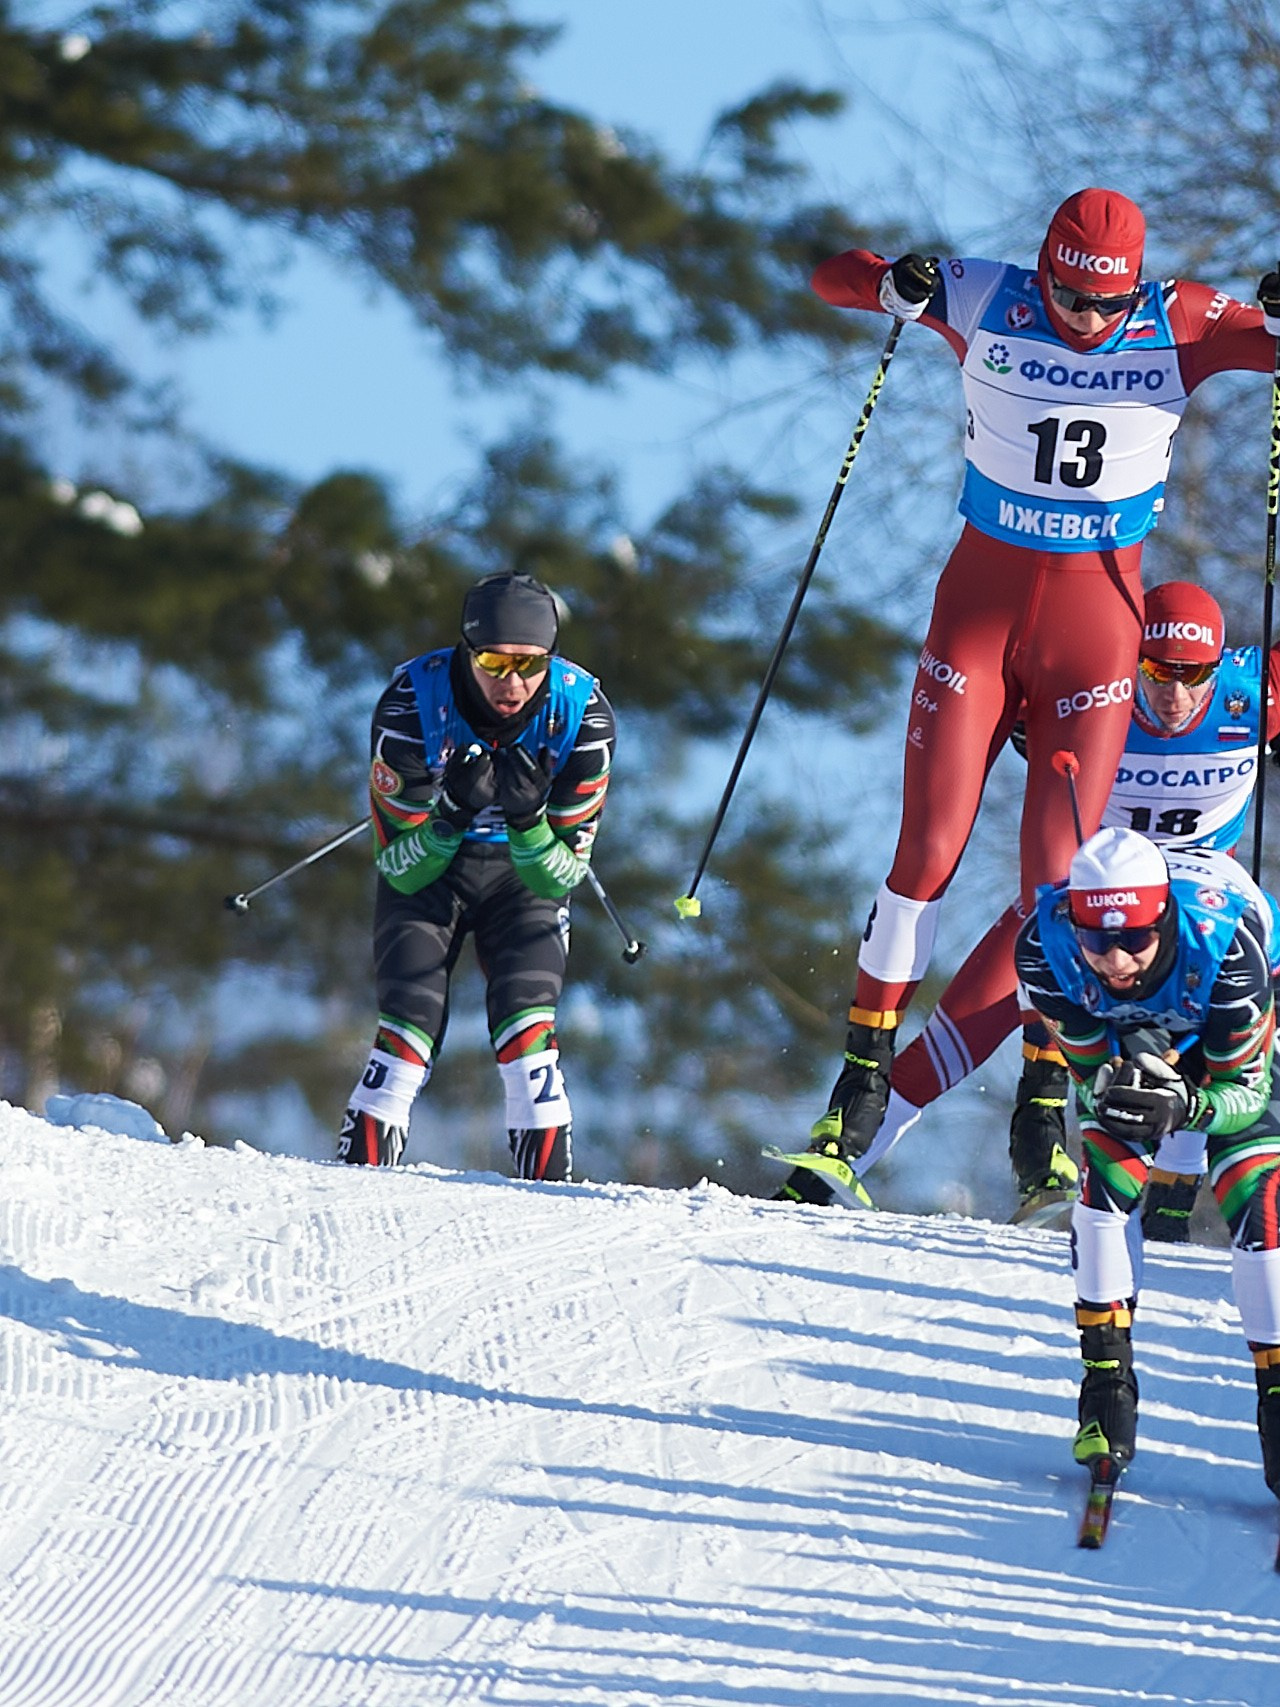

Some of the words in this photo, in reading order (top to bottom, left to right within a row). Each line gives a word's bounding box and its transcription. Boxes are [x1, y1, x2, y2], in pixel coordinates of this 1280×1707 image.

[1056, 242, 1129, 276] LUKOIL
[1019, 359, 1164, 391] ФОСАГРО
[1027, 417, 1107, 488] 13
[999, 499, 1121, 539] ИЖЕВСК
[1144, 621, 1215, 647] LUKOIL
[1056, 677, 1133, 719] BOSCO
[1120, 806, 1202, 836] 18
[376, 832, 428, 877] AZAN
[1086, 892, 1140, 907] LUKOIL
[529, 1065, 560, 1104] 2
